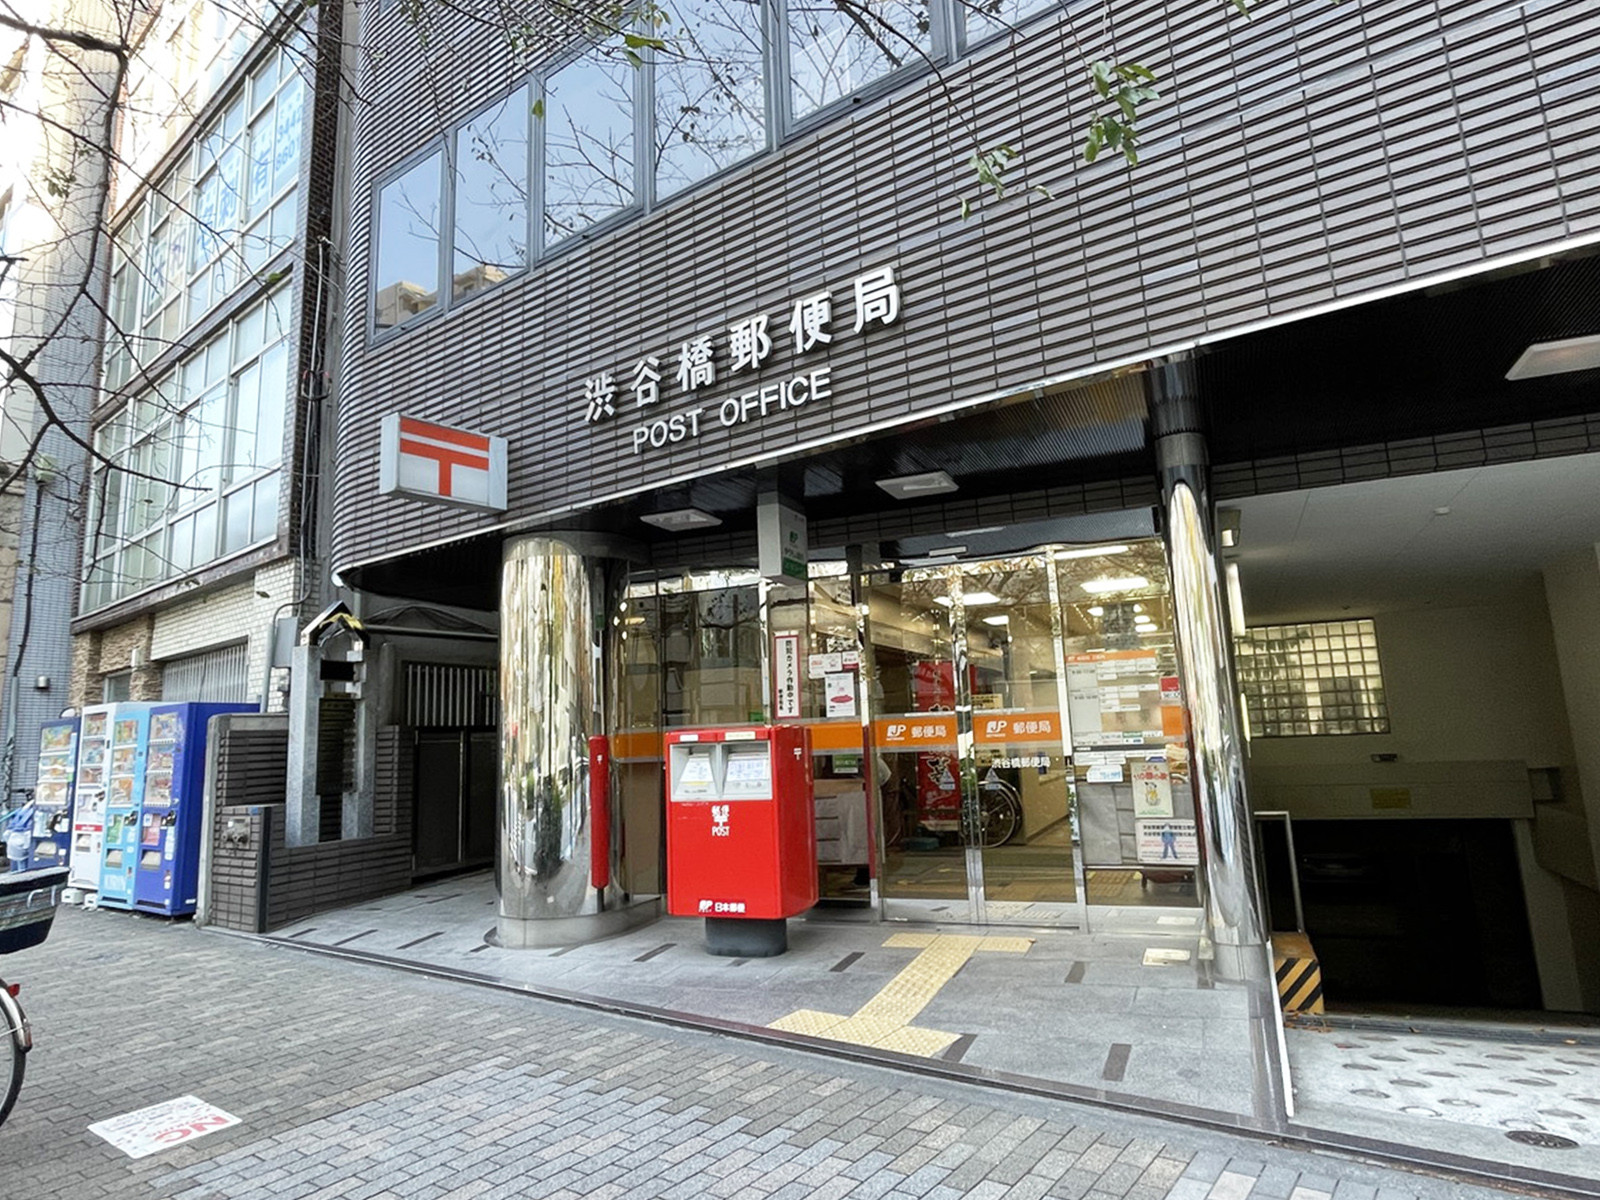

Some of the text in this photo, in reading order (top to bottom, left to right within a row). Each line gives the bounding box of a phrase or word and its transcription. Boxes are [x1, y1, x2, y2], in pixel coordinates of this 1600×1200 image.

[583, 265, 900, 423] 渋谷橋郵便局
[632, 367, 833, 454] POST OFFICE
[911, 725, 947, 738] 郵便局
[1013, 720, 1052, 734] 郵便局
[991, 757, 1052, 769] 渋谷橋郵便局
[711, 826, 730, 836] POST
